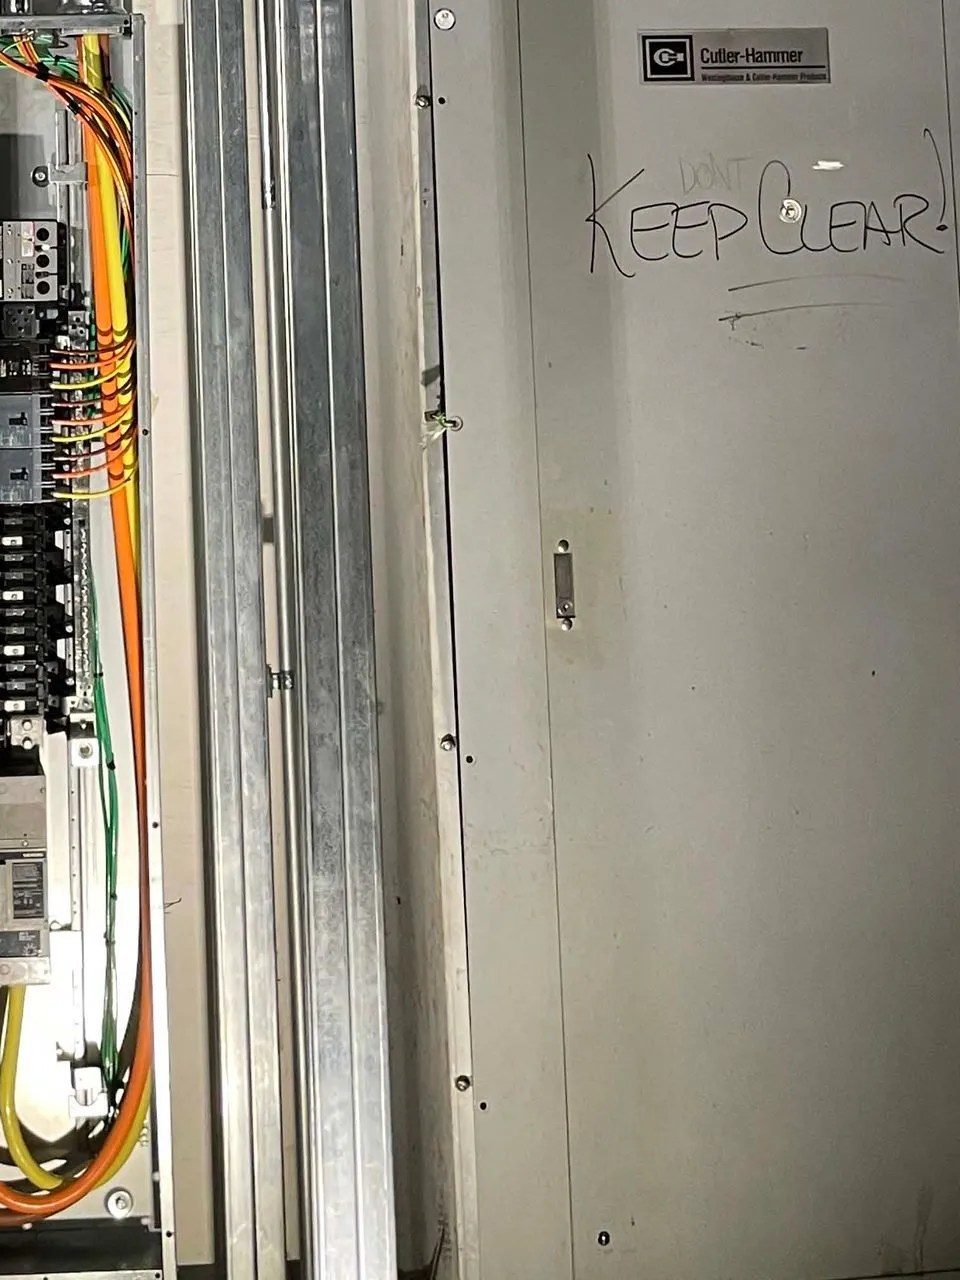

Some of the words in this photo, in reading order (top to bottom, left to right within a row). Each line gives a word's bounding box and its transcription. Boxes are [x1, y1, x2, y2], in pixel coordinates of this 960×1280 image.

[700, 47, 804, 64] Cutler-Hammer
[585, 153, 749, 278] KEEP
[758, 127, 949, 255] CLEAR!
